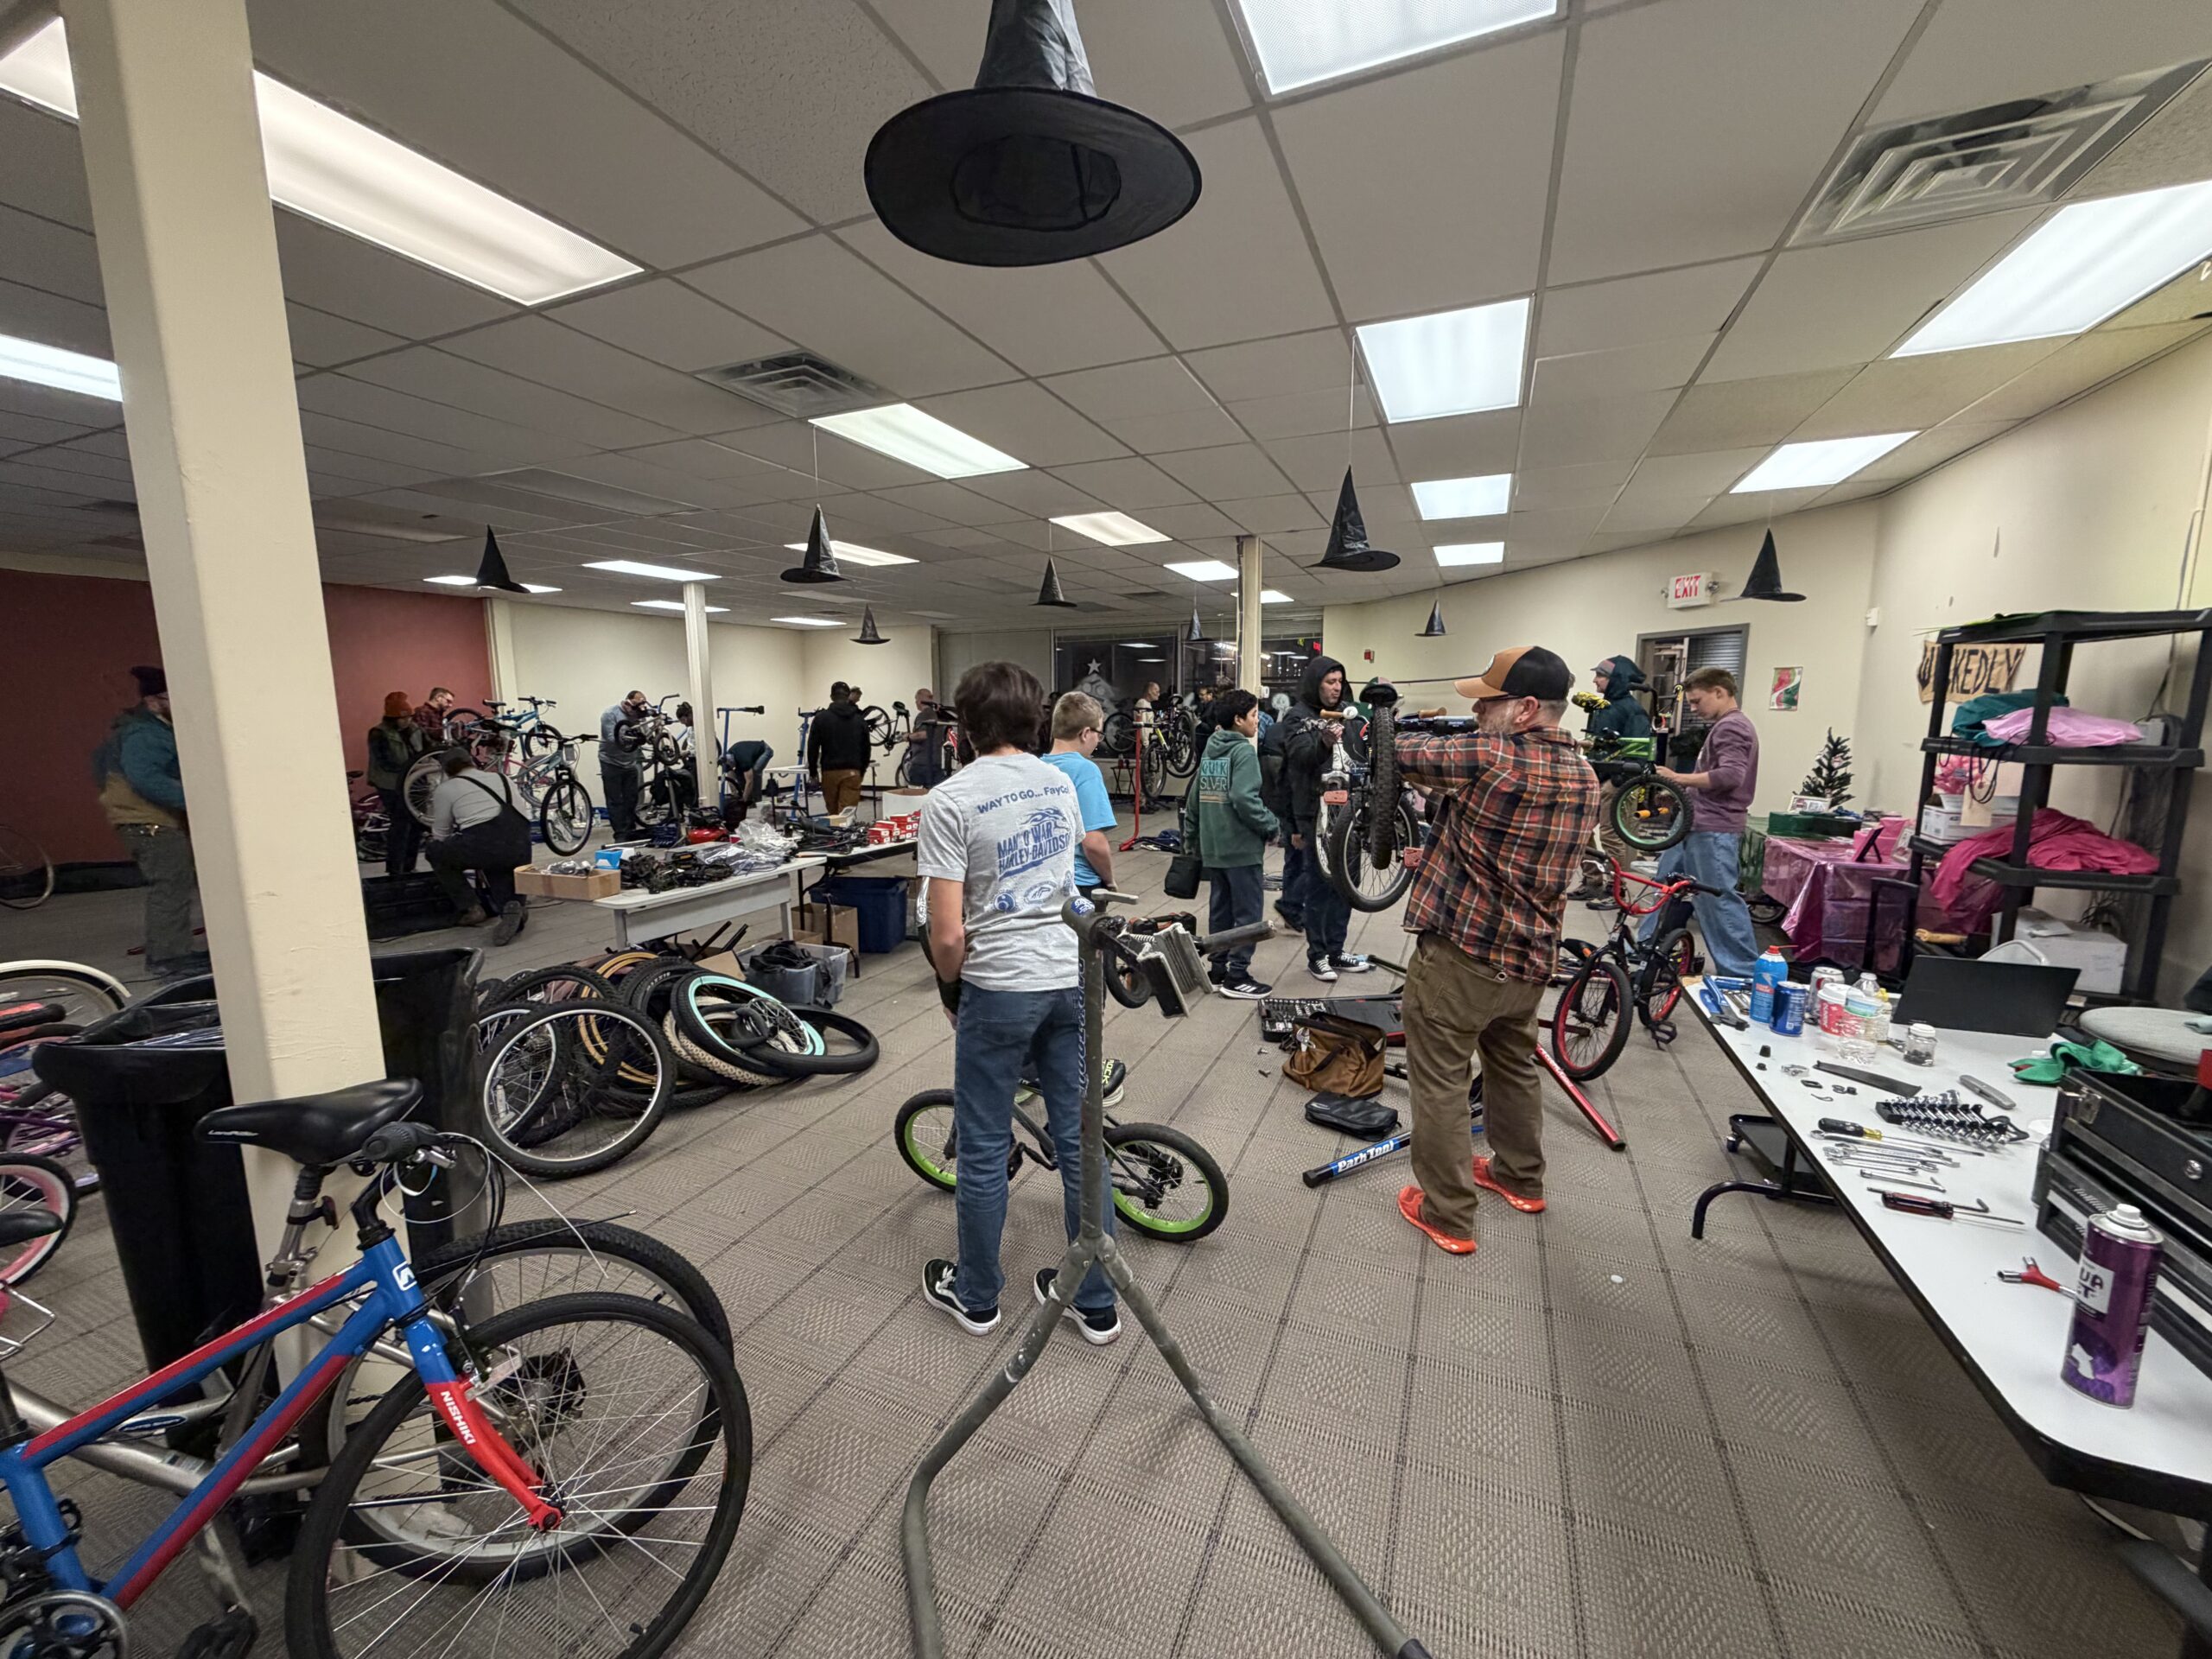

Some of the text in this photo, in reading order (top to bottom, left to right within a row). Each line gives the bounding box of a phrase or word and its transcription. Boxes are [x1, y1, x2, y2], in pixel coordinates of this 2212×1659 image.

[1675, 575, 1701, 599] EXIT
[1917, 645, 2023, 694] WKEDLY
[1202, 760, 1228, 775] QUIK
[977, 797, 1002, 814] WAY
[1003, 792, 1019, 804] TO
[997, 832, 1019, 860] MAN
[1031, 821, 1053, 844] WAR
[440, 1390, 477, 1445] NISHIKI
